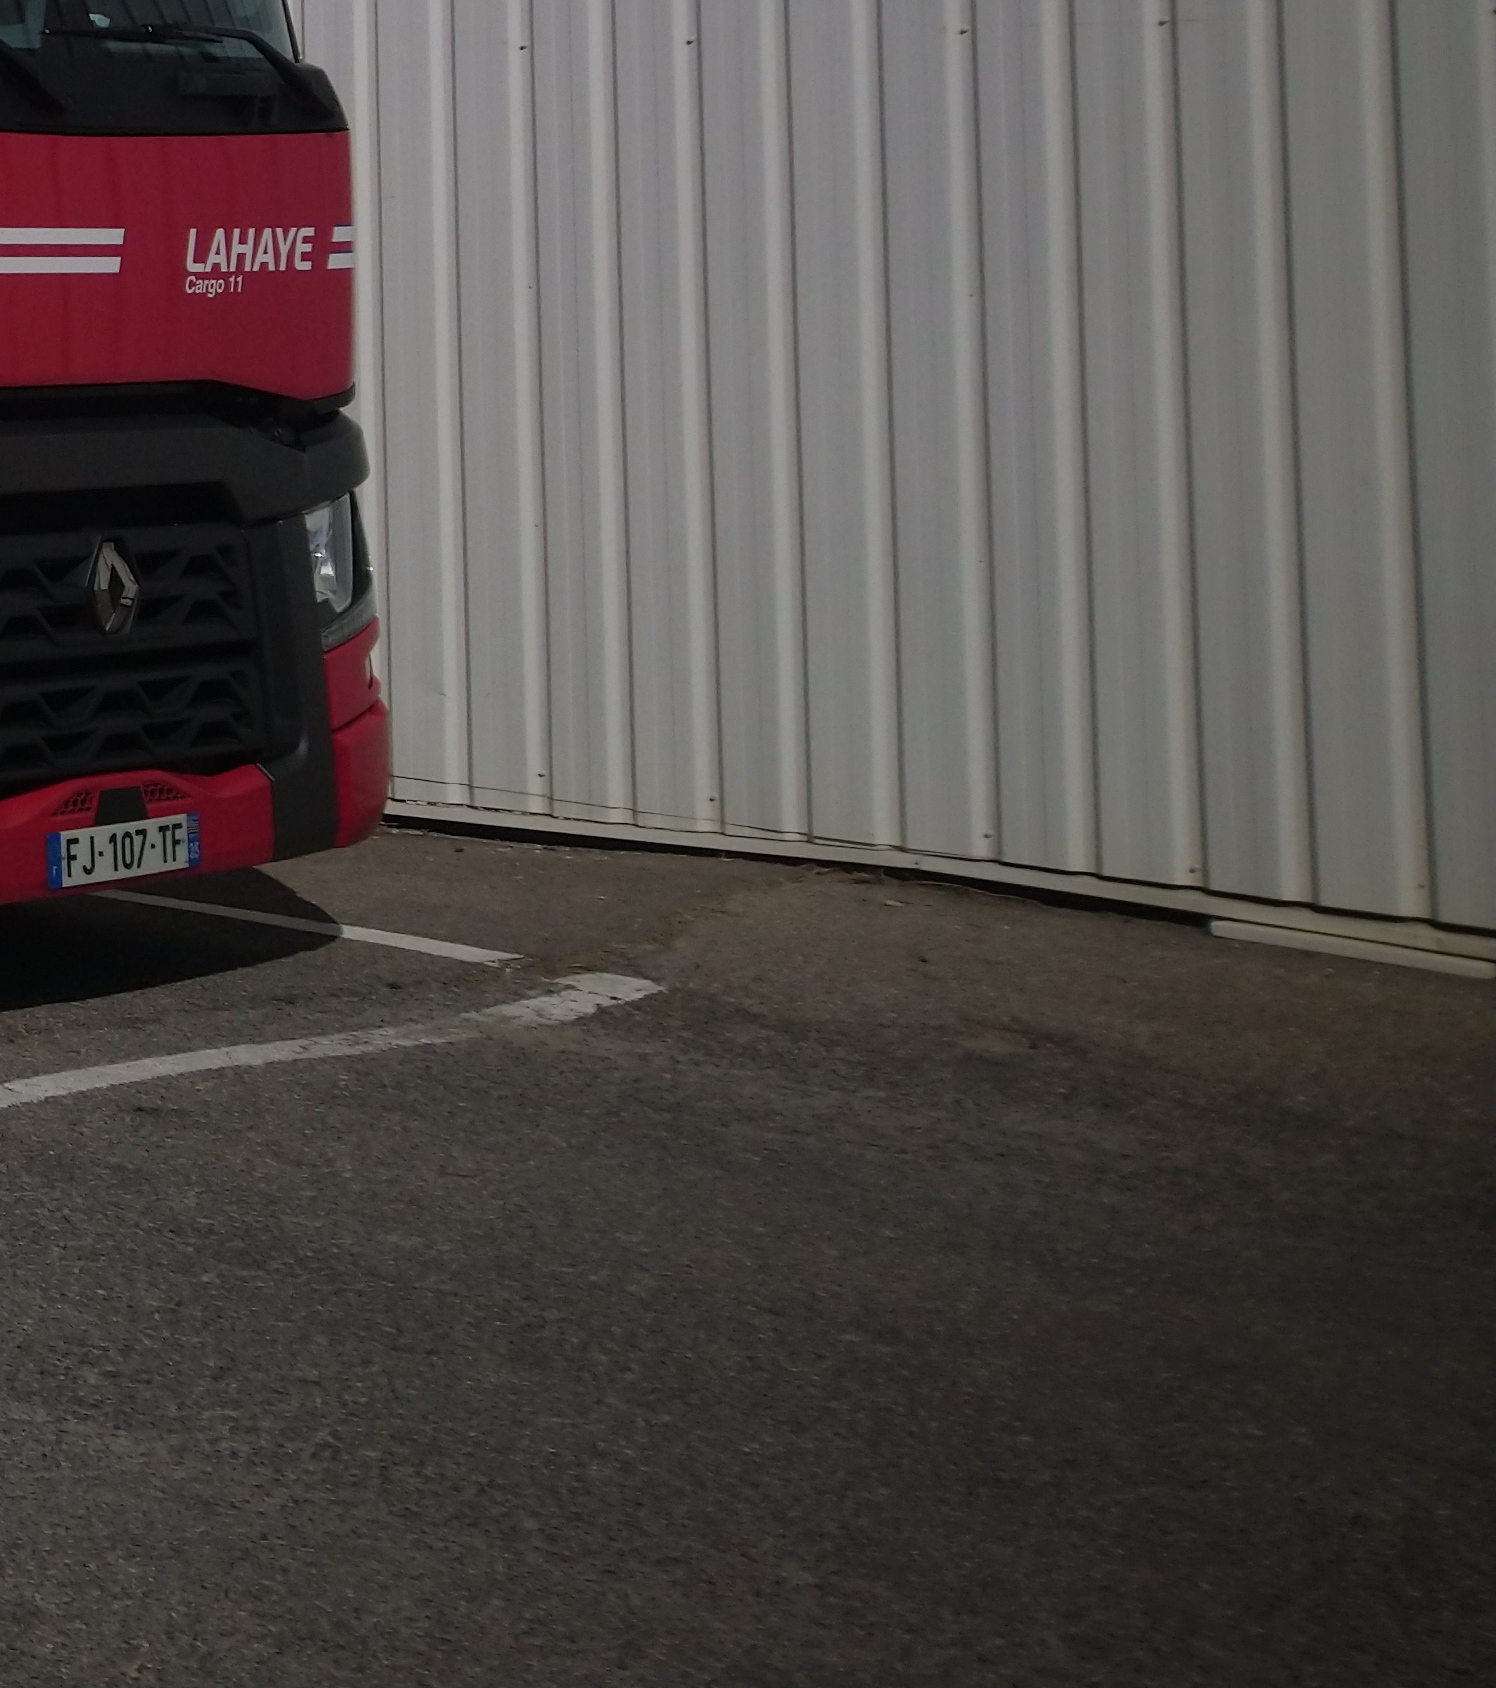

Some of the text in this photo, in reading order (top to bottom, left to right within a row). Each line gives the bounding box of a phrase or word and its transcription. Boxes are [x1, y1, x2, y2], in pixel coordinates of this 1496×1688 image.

[186, 227, 315, 272] LAHAYE
[185, 275, 243, 297] Cargo 11
[66, 823, 183, 878] FJ-107-TF
